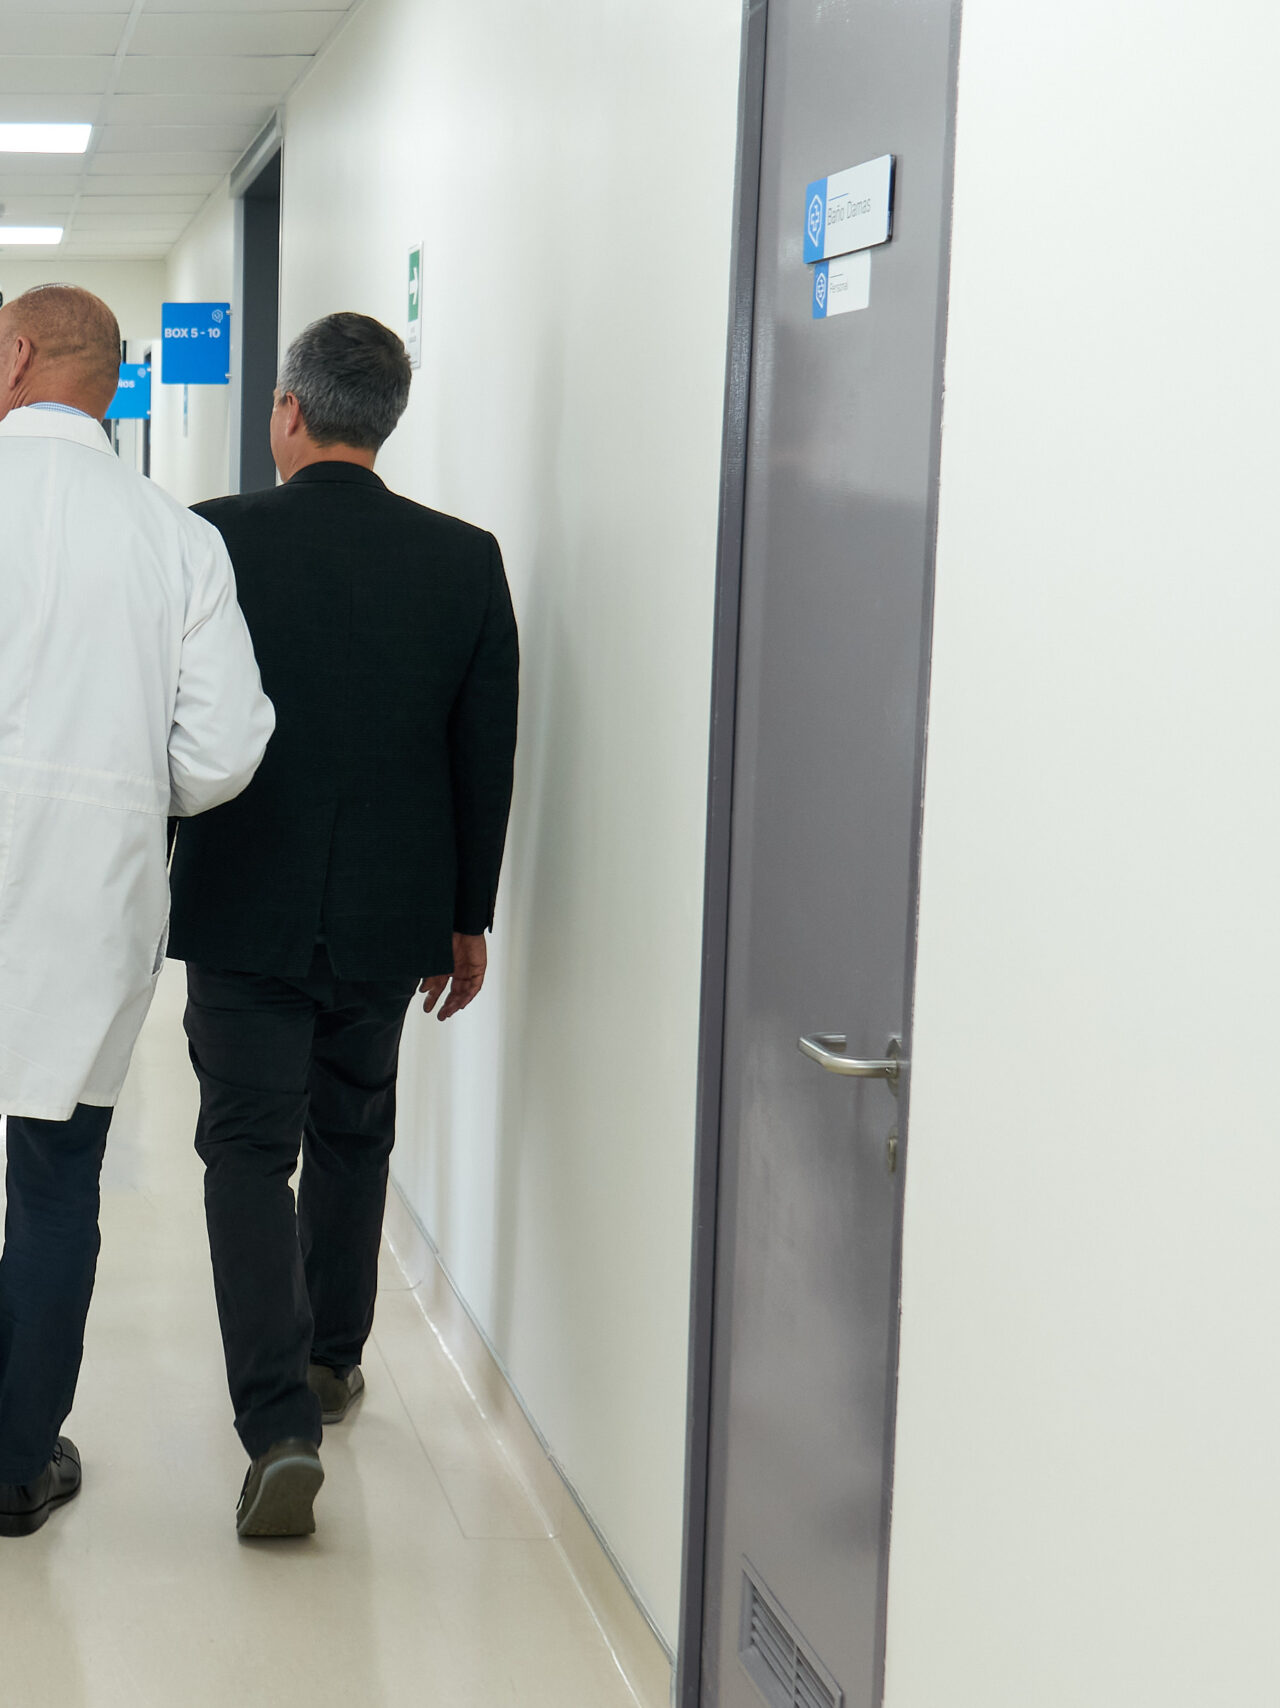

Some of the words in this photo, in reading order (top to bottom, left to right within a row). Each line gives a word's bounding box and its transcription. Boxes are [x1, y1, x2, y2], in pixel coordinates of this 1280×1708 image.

[847, 198, 871, 219] Damas
[164, 328, 188, 338] BOX
[191, 328, 198, 338] 5
[208, 328, 221, 338] 10
